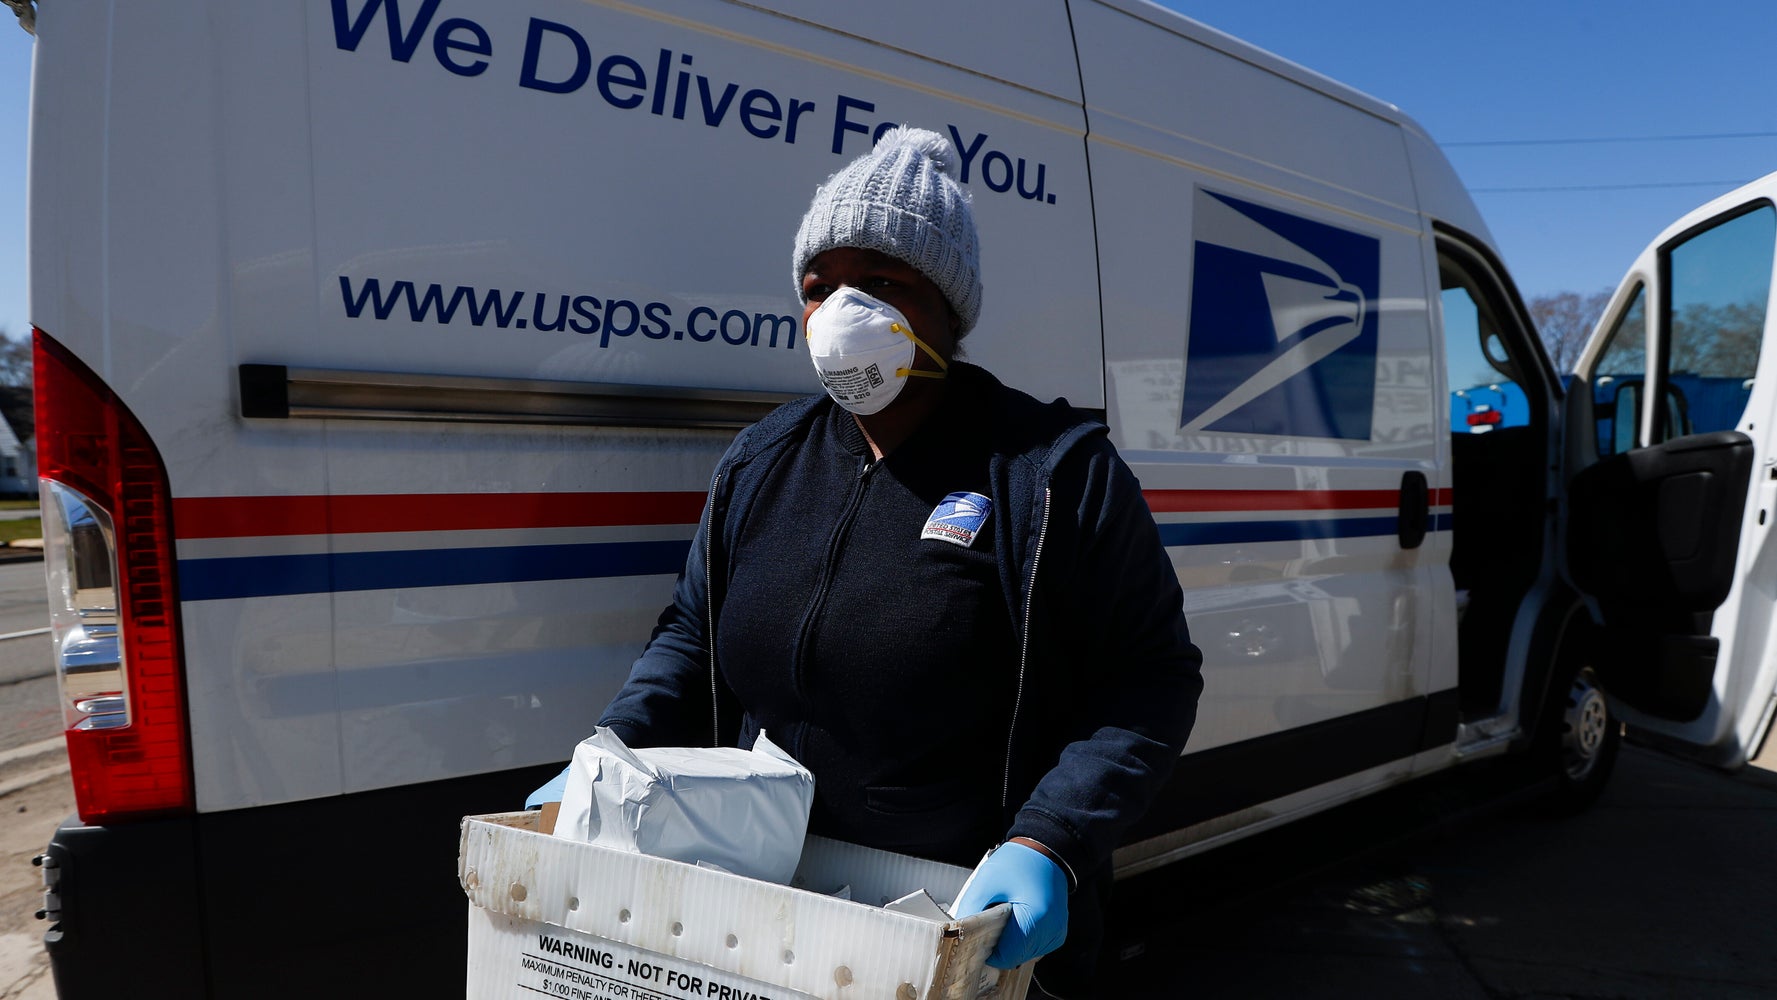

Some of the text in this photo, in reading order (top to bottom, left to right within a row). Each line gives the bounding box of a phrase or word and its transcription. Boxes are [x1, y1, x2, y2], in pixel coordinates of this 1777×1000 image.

[331, 0, 492, 77] We
[518, 16, 816, 145] Deliver
[947, 124, 1057, 204] You.
[339, 275, 797, 349] www.usps.com
[828, 367, 859, 376] WARNING
[867, 367, 881, 385] N95
[522, 958, 565, 980] MAXIMUM
[566, 971, 607, 992] PENALTY
[608, 982, 629, 998] FOR
[539, 935, 613, 969] WARNING
[628, 959, 663, 982] NOT
[667, 970, 703, 996] FOR
[571, 988, 592, 1000] FINE
